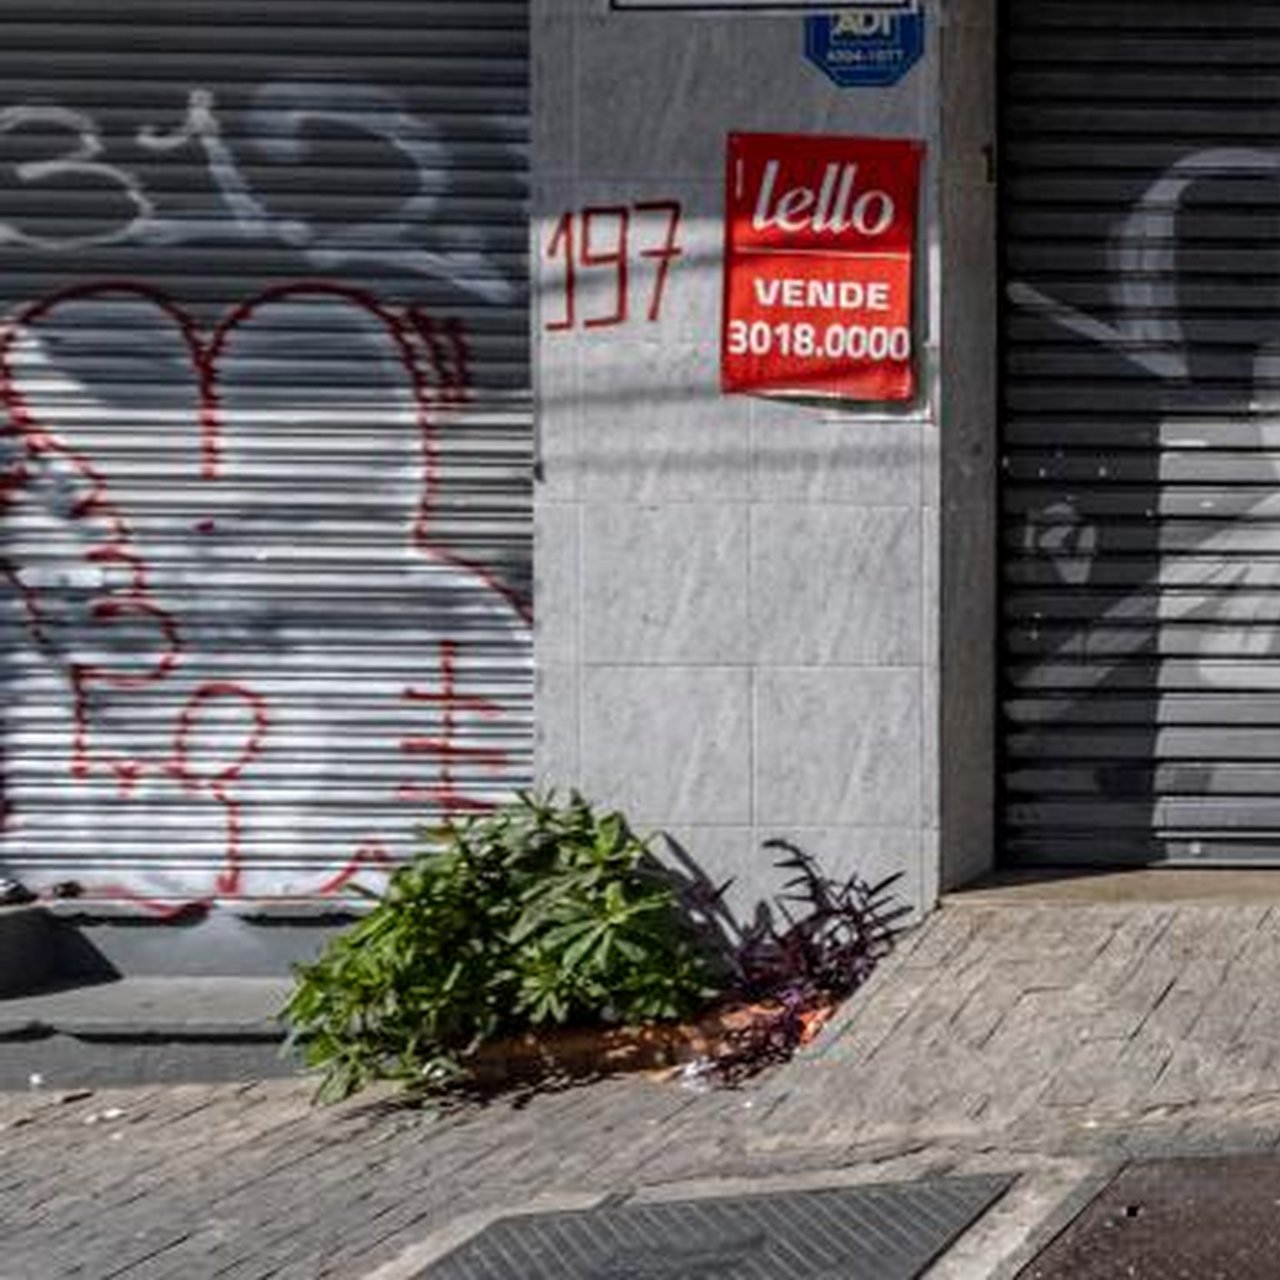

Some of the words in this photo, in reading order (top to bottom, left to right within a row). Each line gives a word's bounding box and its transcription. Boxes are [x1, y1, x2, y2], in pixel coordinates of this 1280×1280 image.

[751, 159, 895, 236] lello
[545, 198, 683, 333] 197
[753, 277, 892, 310] VENDE
[727, 320, 911, 361] 3018.0000
